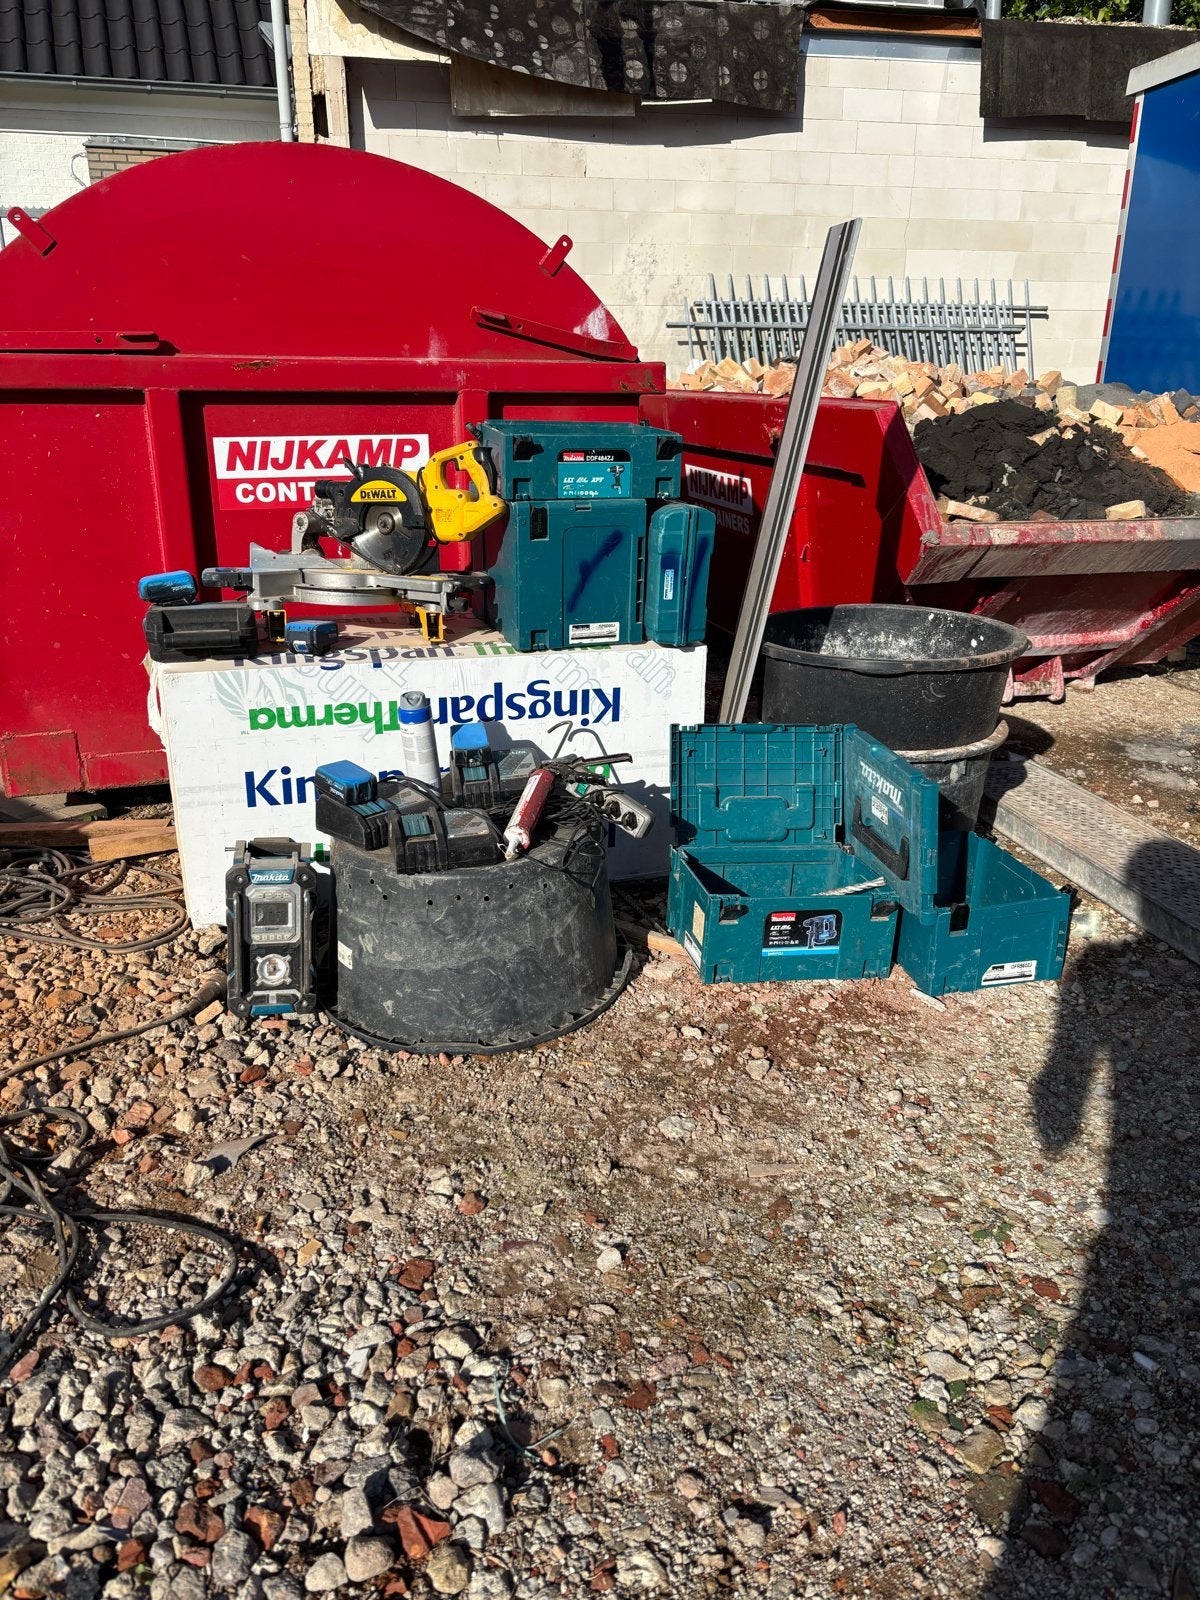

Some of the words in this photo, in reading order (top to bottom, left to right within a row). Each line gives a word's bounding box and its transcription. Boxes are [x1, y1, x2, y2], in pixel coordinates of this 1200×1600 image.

[226, 438, 420, 471] NIJKAMP
[235, 481, 315, 503] CONT
[689, 468, 749, 506] NIJKAMP
[248, 700, 401, 735] Therma
[426, 679, 621, 727] Kingspan
